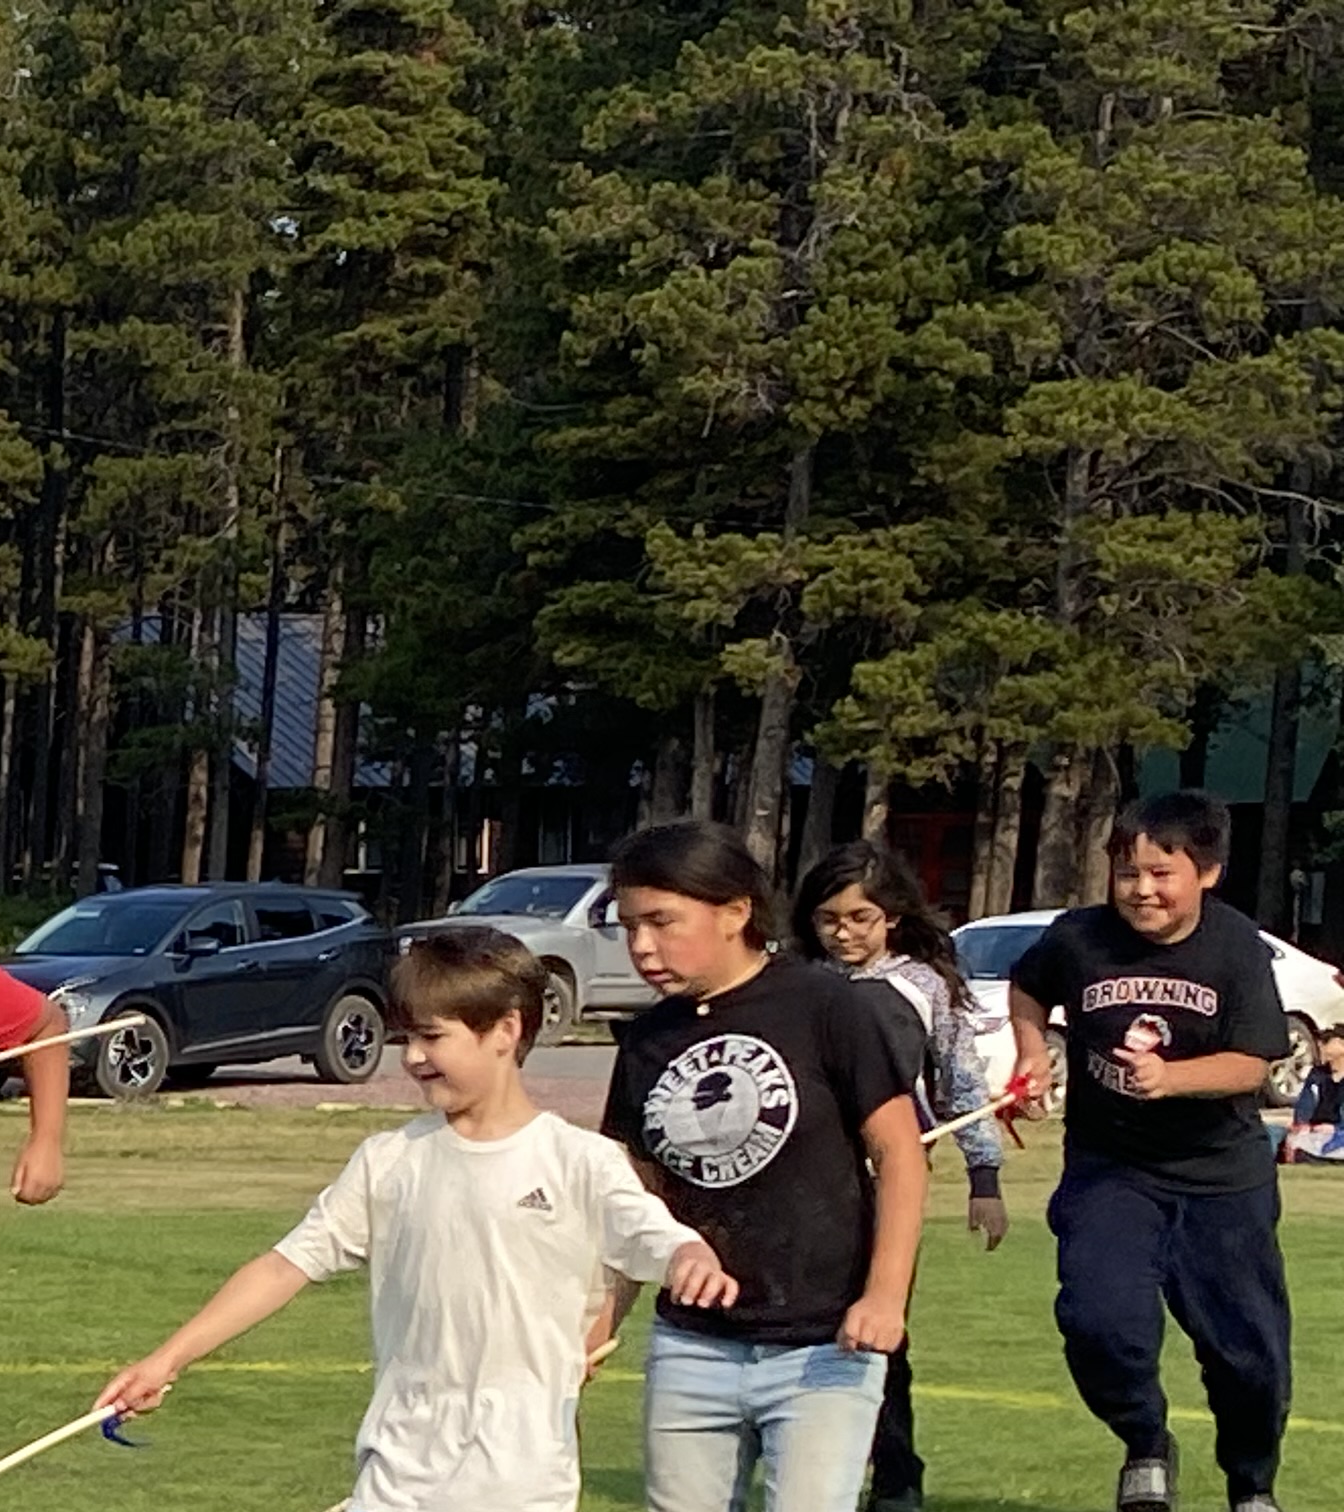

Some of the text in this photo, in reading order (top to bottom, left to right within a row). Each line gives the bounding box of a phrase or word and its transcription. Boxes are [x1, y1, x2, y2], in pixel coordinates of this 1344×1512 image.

[1081, 976, 1218, 1017] BROWNING
[642, 1040, 790, 1131] SWEET PEAKS
[653, 1120, 784, 1182] ICE CREAM
